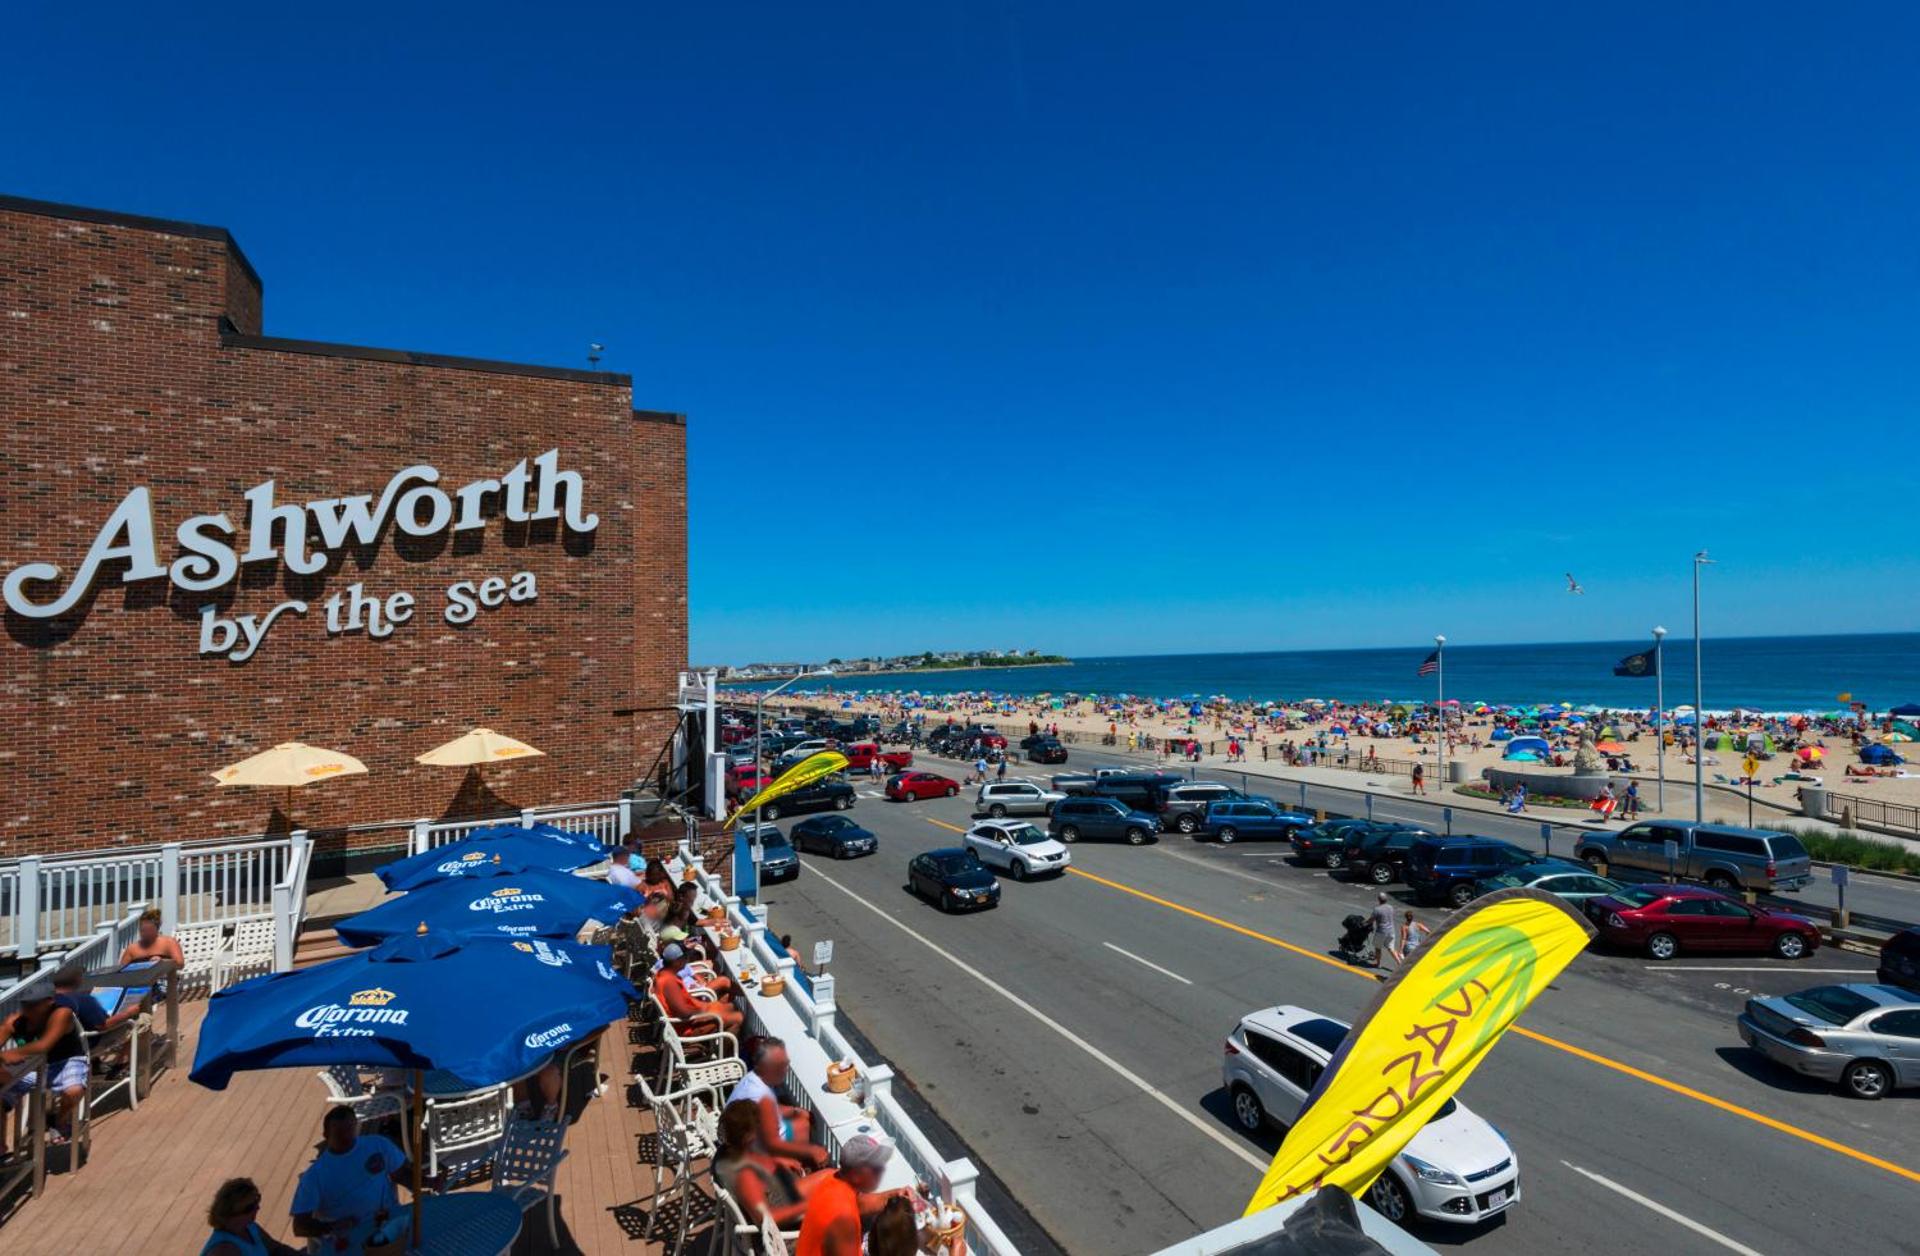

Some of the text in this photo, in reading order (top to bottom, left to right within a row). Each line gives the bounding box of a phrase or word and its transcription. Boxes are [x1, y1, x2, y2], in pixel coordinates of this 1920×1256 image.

[3, 448, 599, 618] Ashworth
[200, 572, 538, 662] by the sea
[469, 894, 545, 911] Corona
[295, 1004, 408, 1029] Corona
[525, 1023, 572, 1048] Corona
